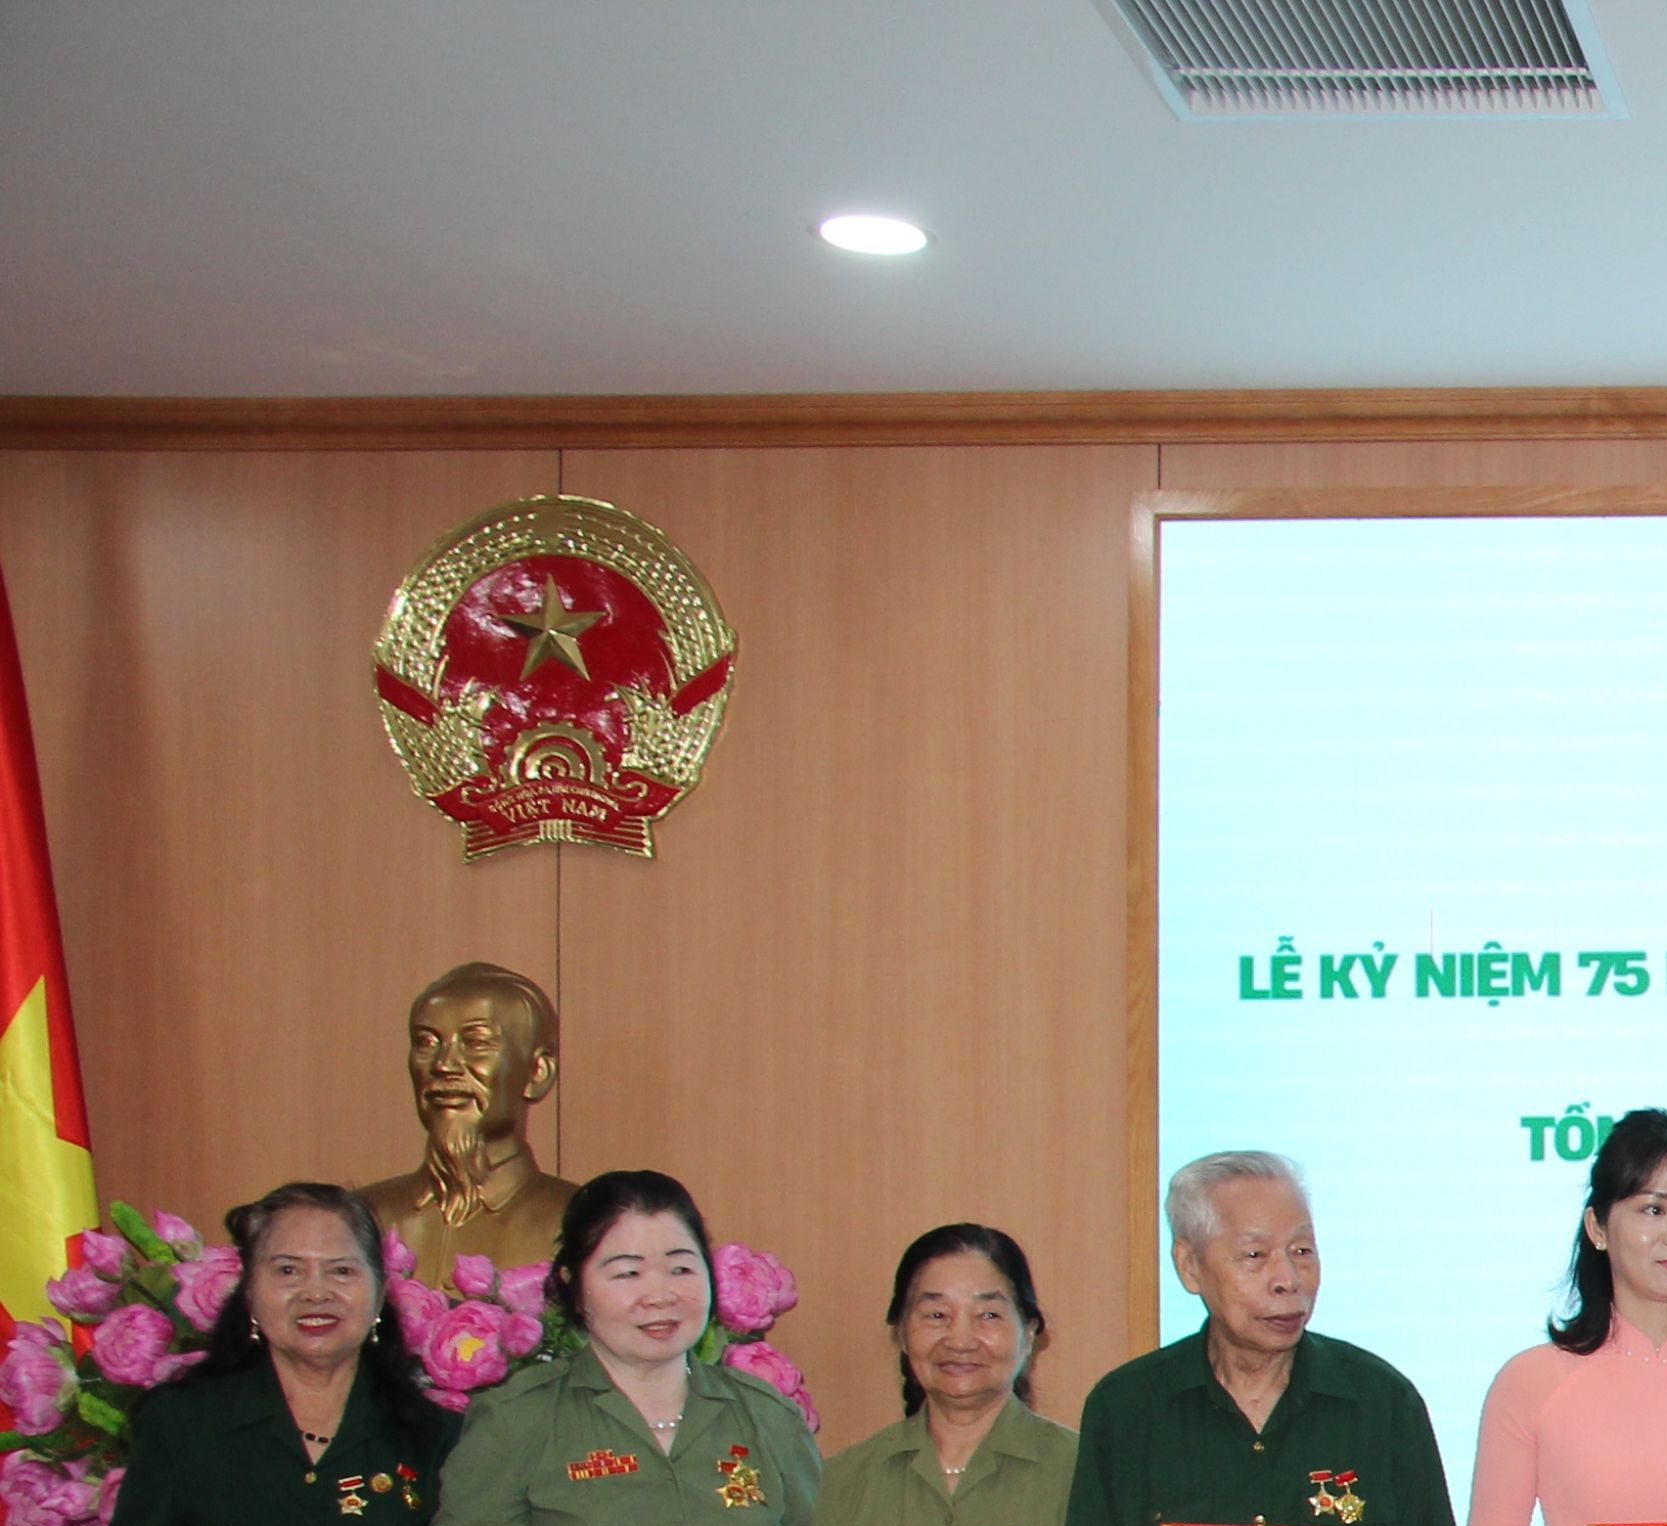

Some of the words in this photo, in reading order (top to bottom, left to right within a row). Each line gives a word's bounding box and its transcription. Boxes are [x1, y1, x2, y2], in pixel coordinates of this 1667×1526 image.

[561, 798, 608, 823] NAM
[1239, 935, 1304, 1001] LỄ
[1318, 941, 1399, 999] KỶ
[1414, 941, 1562, 1008] NIỆM
[1577, 950, 1651, 997] 75
[1520, 1101, 1621, 1162] TỔ
